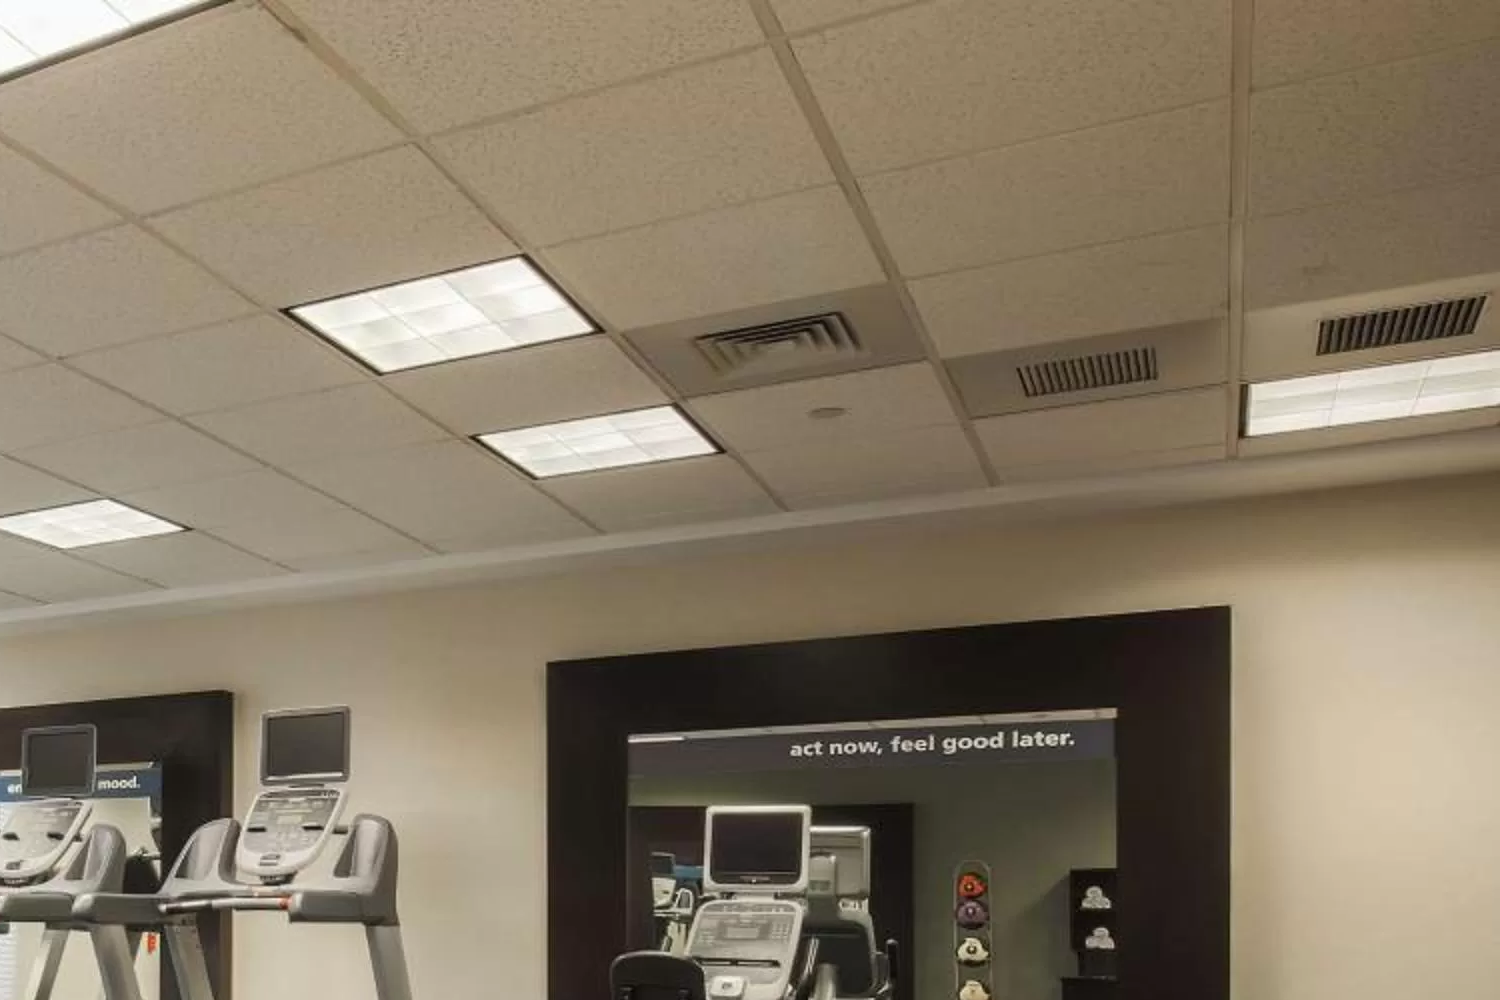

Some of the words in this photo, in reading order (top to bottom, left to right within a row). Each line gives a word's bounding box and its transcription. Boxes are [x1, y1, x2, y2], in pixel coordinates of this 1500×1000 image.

[790, 741, 823, 757] act
[829, 740, 882, 755] now,
[890, 735, 934, 752] feel
[942, 731, 1004, 754] good
[1012, 730, 1075, 747] later.
[97, 775, 141, 790] mood.
